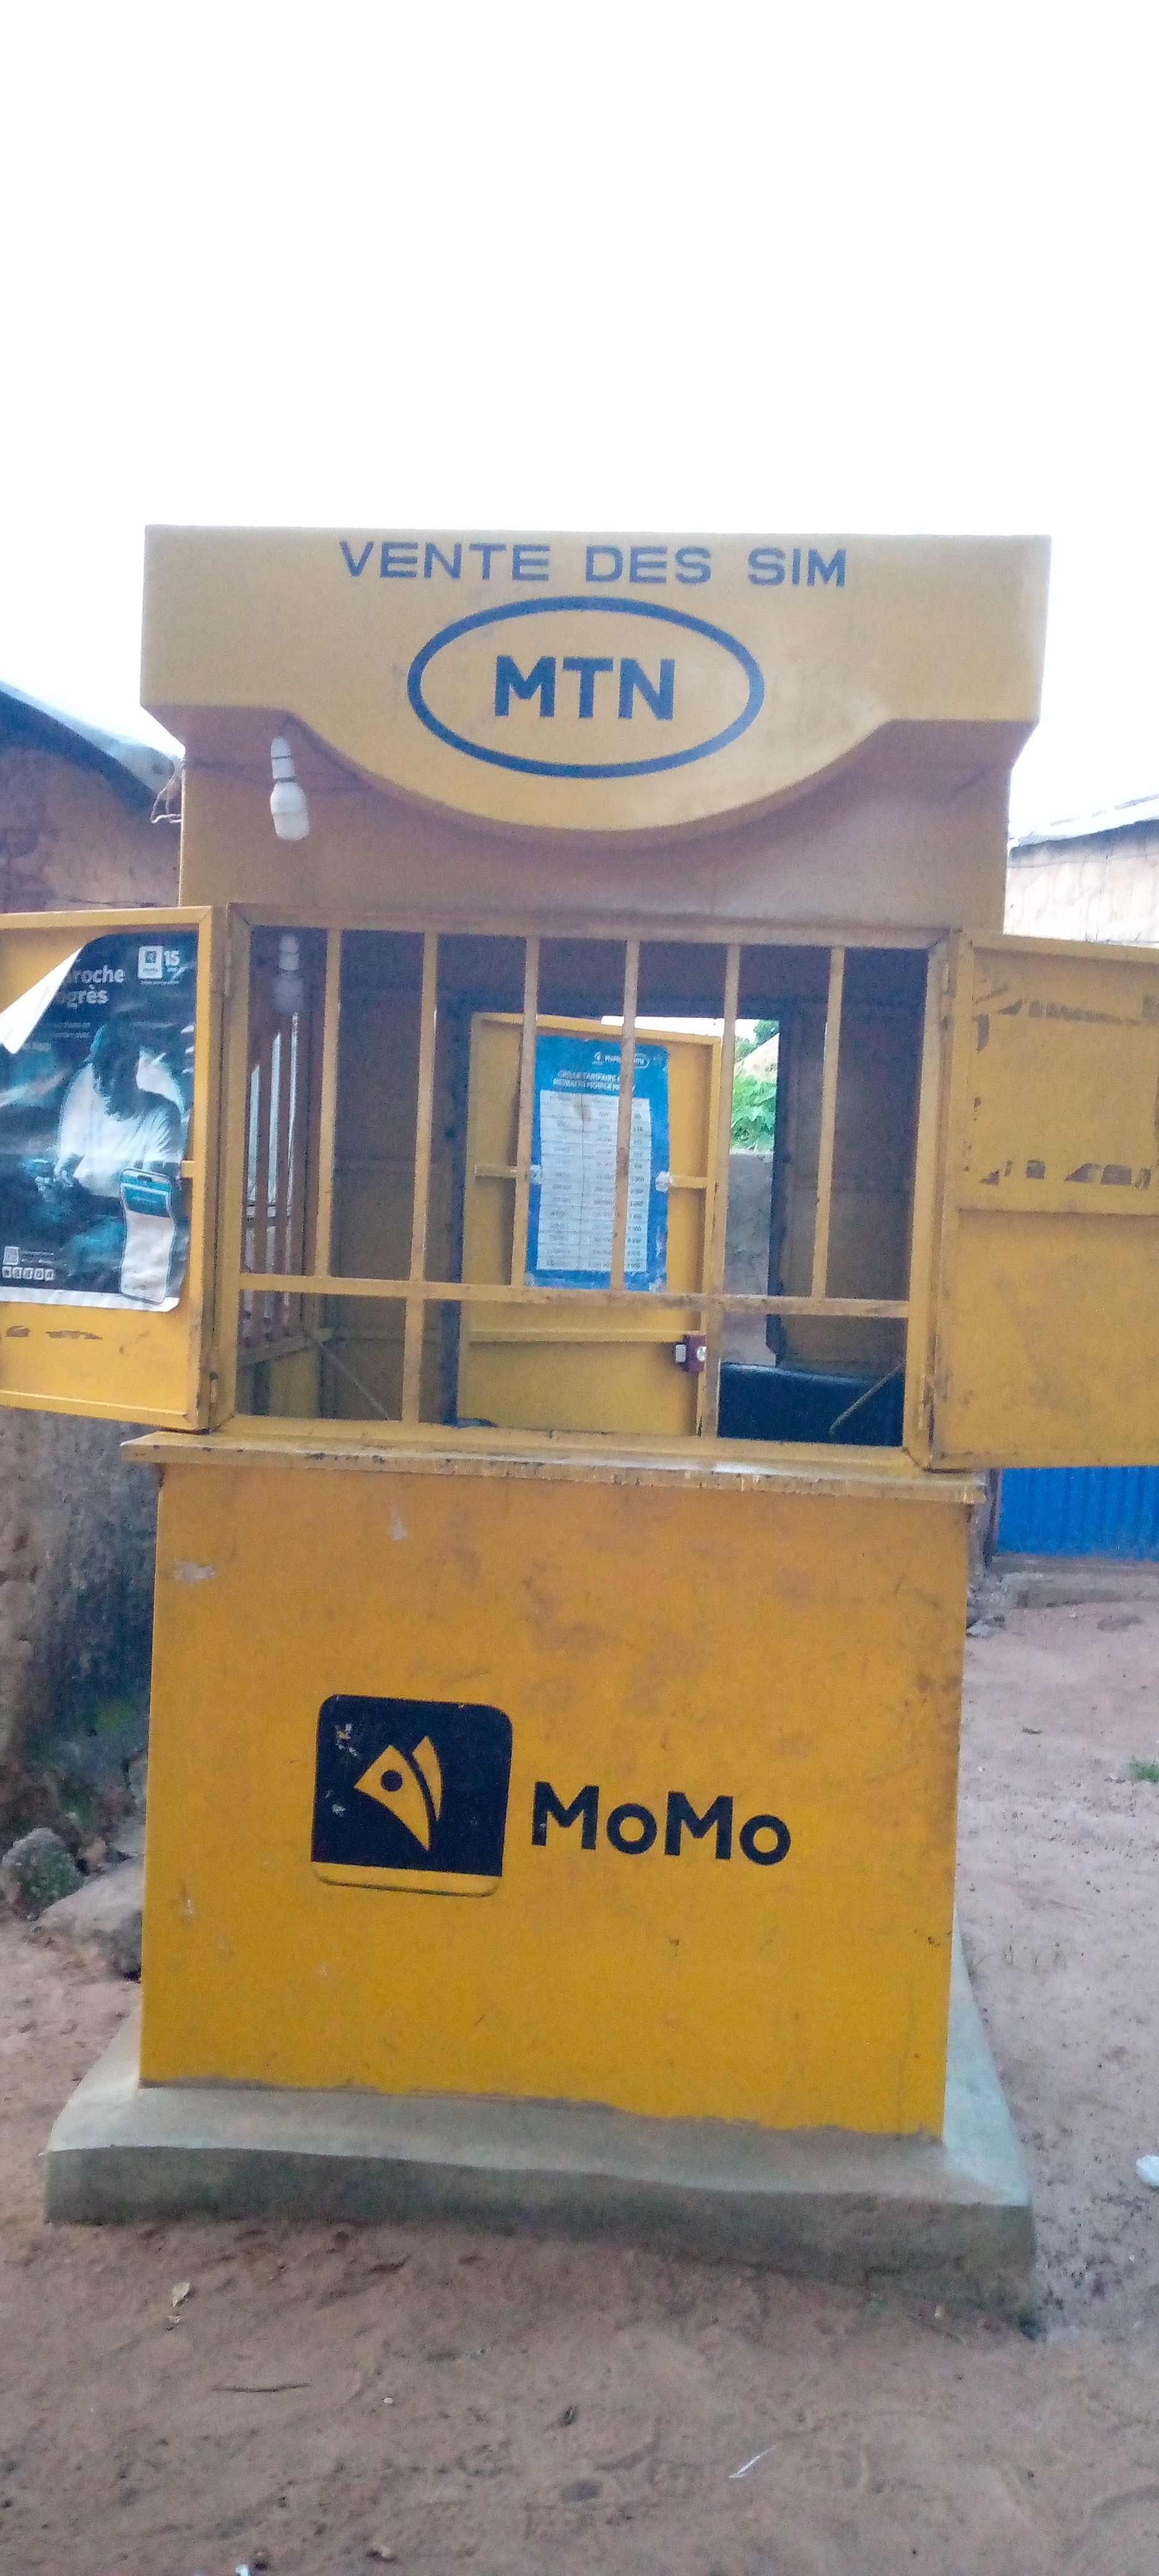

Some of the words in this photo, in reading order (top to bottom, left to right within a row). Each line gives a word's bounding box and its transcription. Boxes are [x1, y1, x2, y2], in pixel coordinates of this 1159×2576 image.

[340, 541, 550, 581] VENTE
[585, 546, 712, 585] DES
[748, 548, 847, 588] SIM
[495, 655, 674, 720] MTN
[164, 950, 180, 965] 15
[532, 1781, 791, 1866] MoMo
